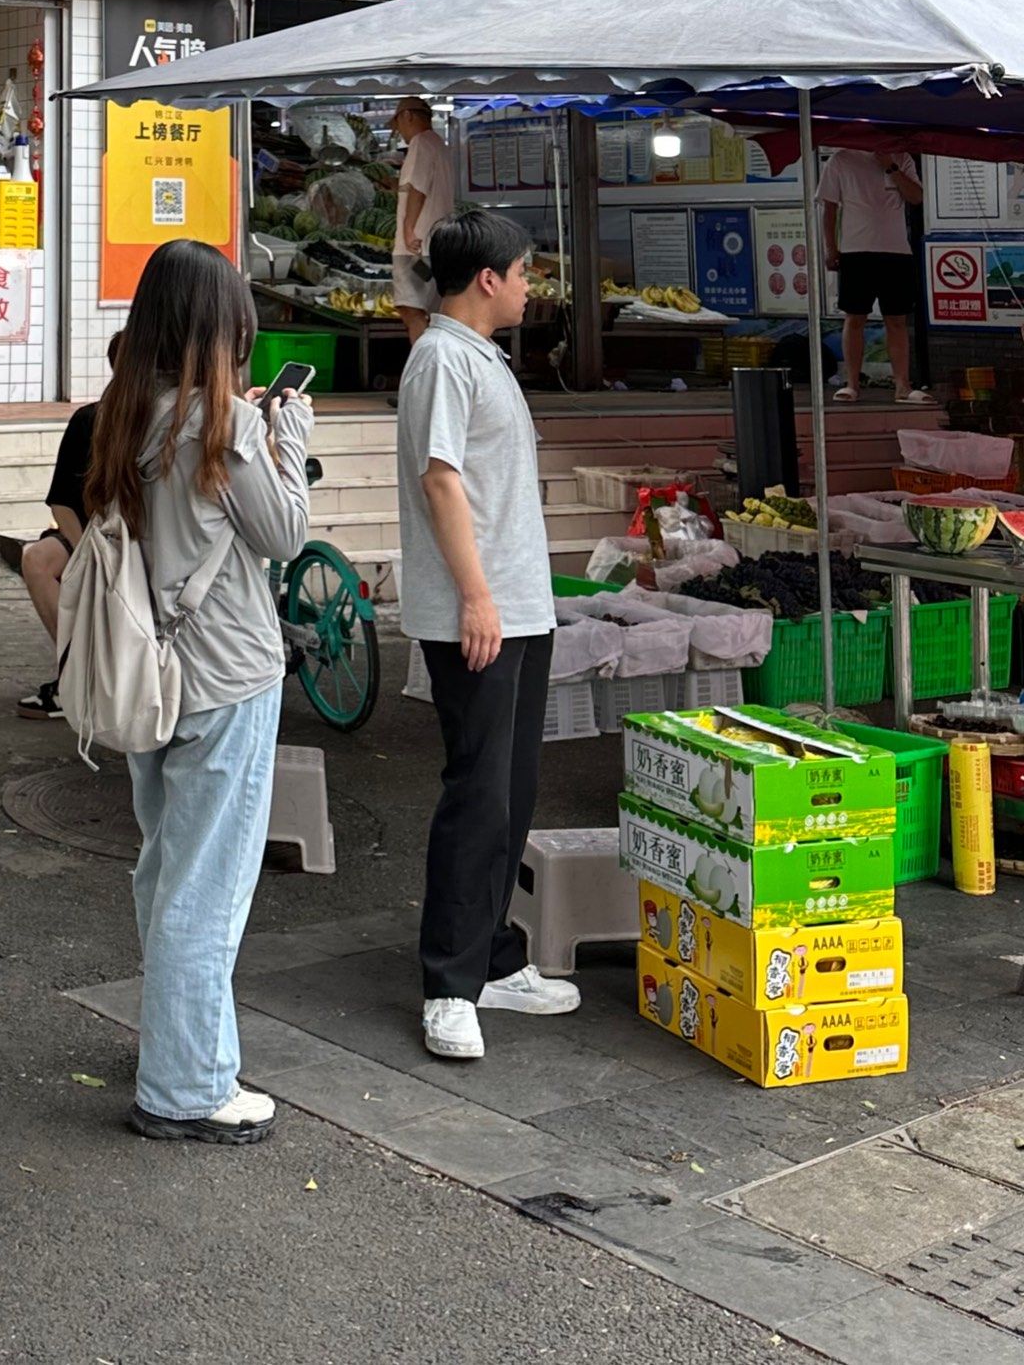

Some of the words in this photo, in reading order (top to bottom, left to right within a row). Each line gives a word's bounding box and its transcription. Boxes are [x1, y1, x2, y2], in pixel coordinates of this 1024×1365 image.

[128, 35, 206, 68] 人气榜
[134, 121, 202, 142] 上榜餐厅
[636, 744, 685, 788] 奶香蜜
[632, 826, 682, 874] 奶香蜜
[812, 935, 844, 951] AAAA
[821, 1013, 852, 1029] AAAA
